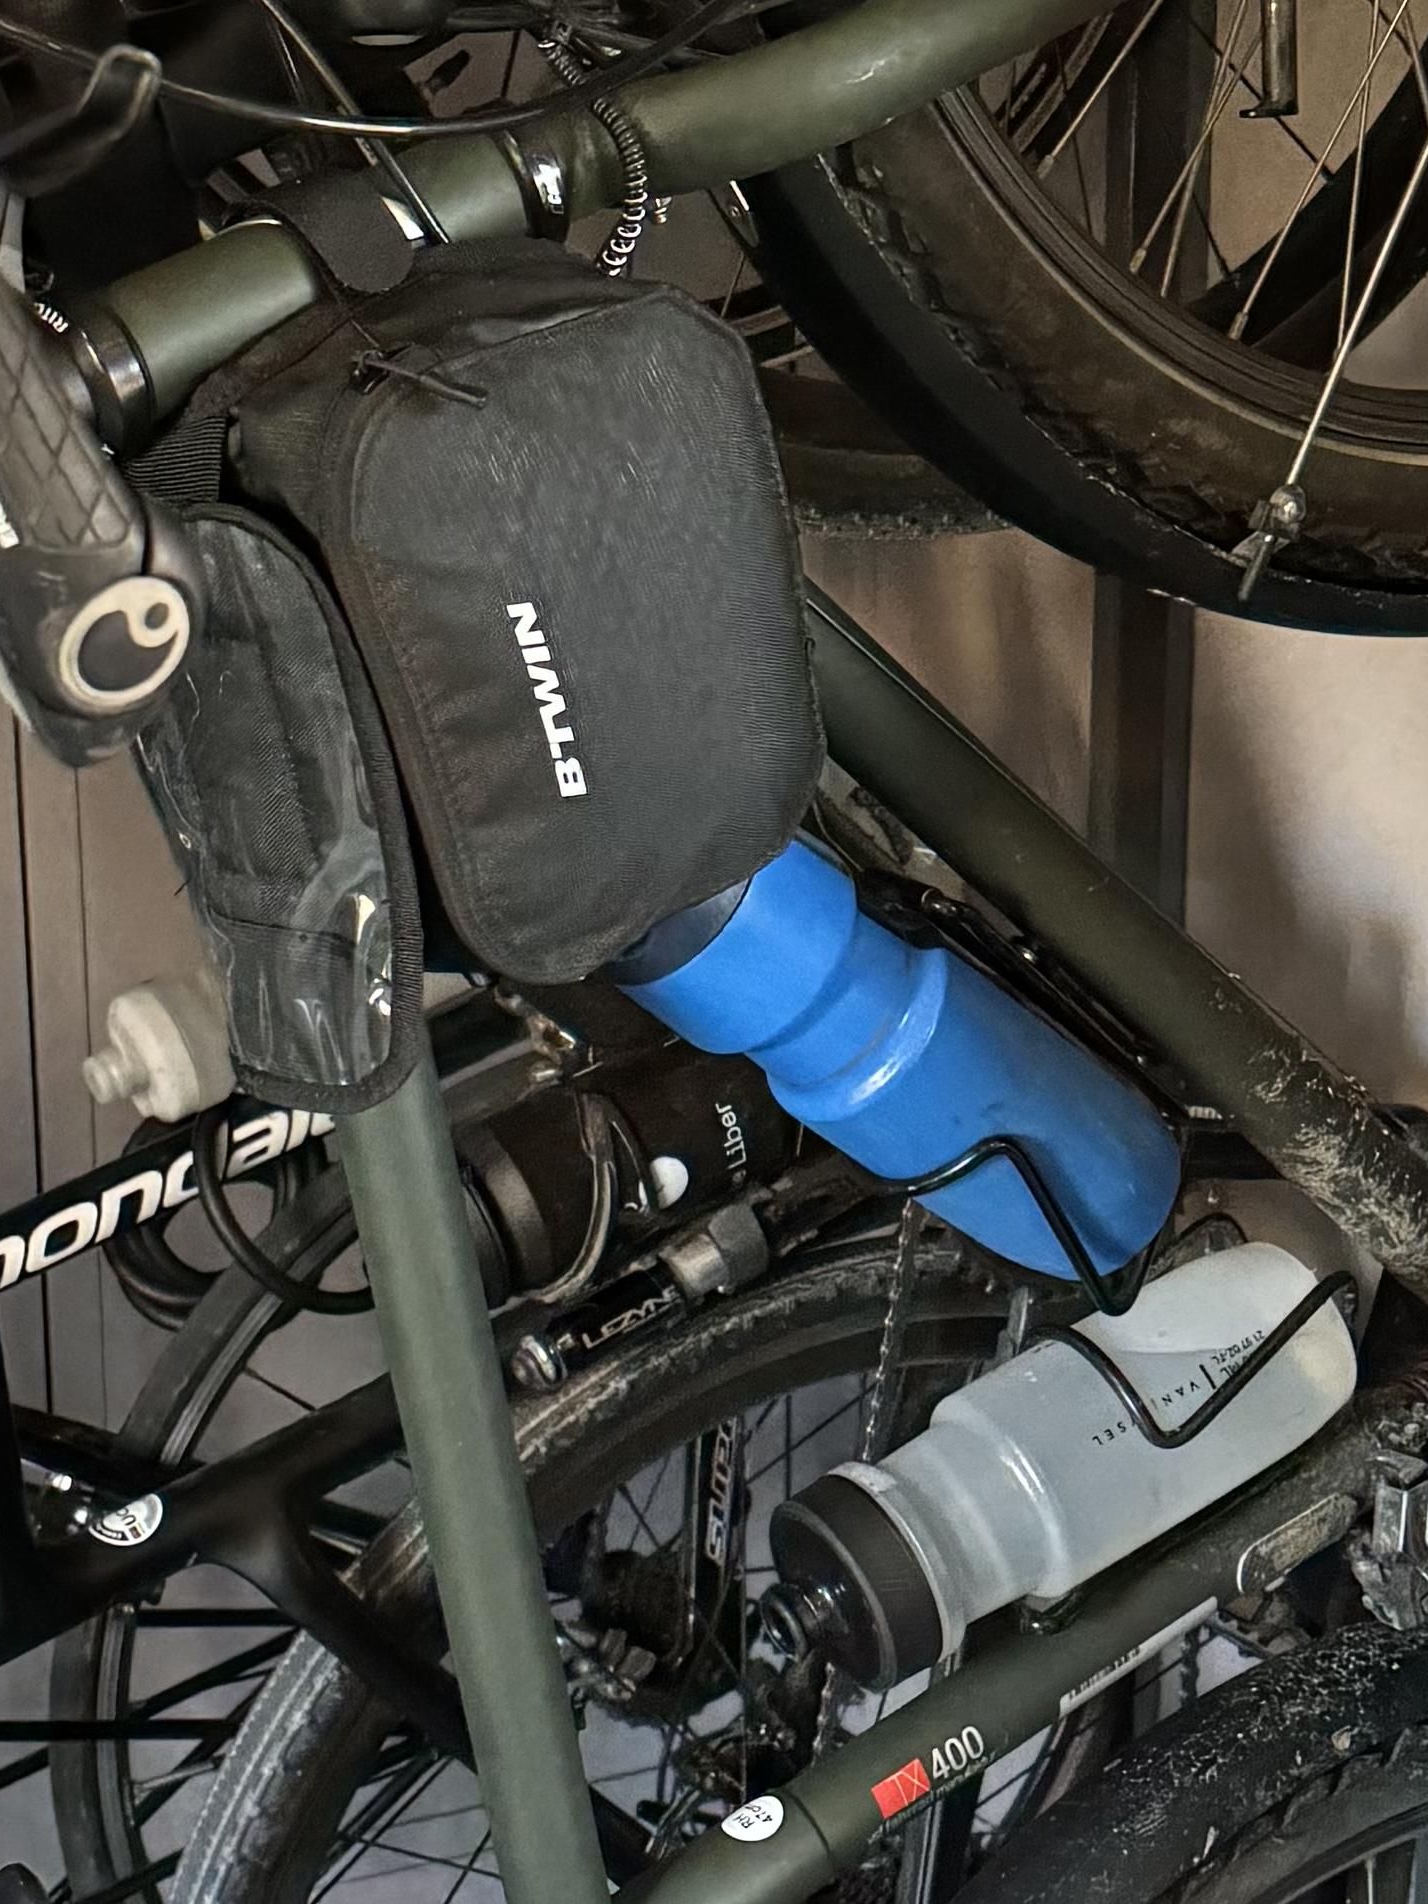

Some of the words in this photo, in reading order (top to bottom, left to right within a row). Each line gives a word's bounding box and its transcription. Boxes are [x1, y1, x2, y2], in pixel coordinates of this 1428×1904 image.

[34, 301, 69, 334] RITC
[714, 1101, 747, 1171] Liber
[1161, 1381, 1201, 1407] VAN
[931, 1725, 985, 1782] 400
[732, 1812, 755, 1829] RH
